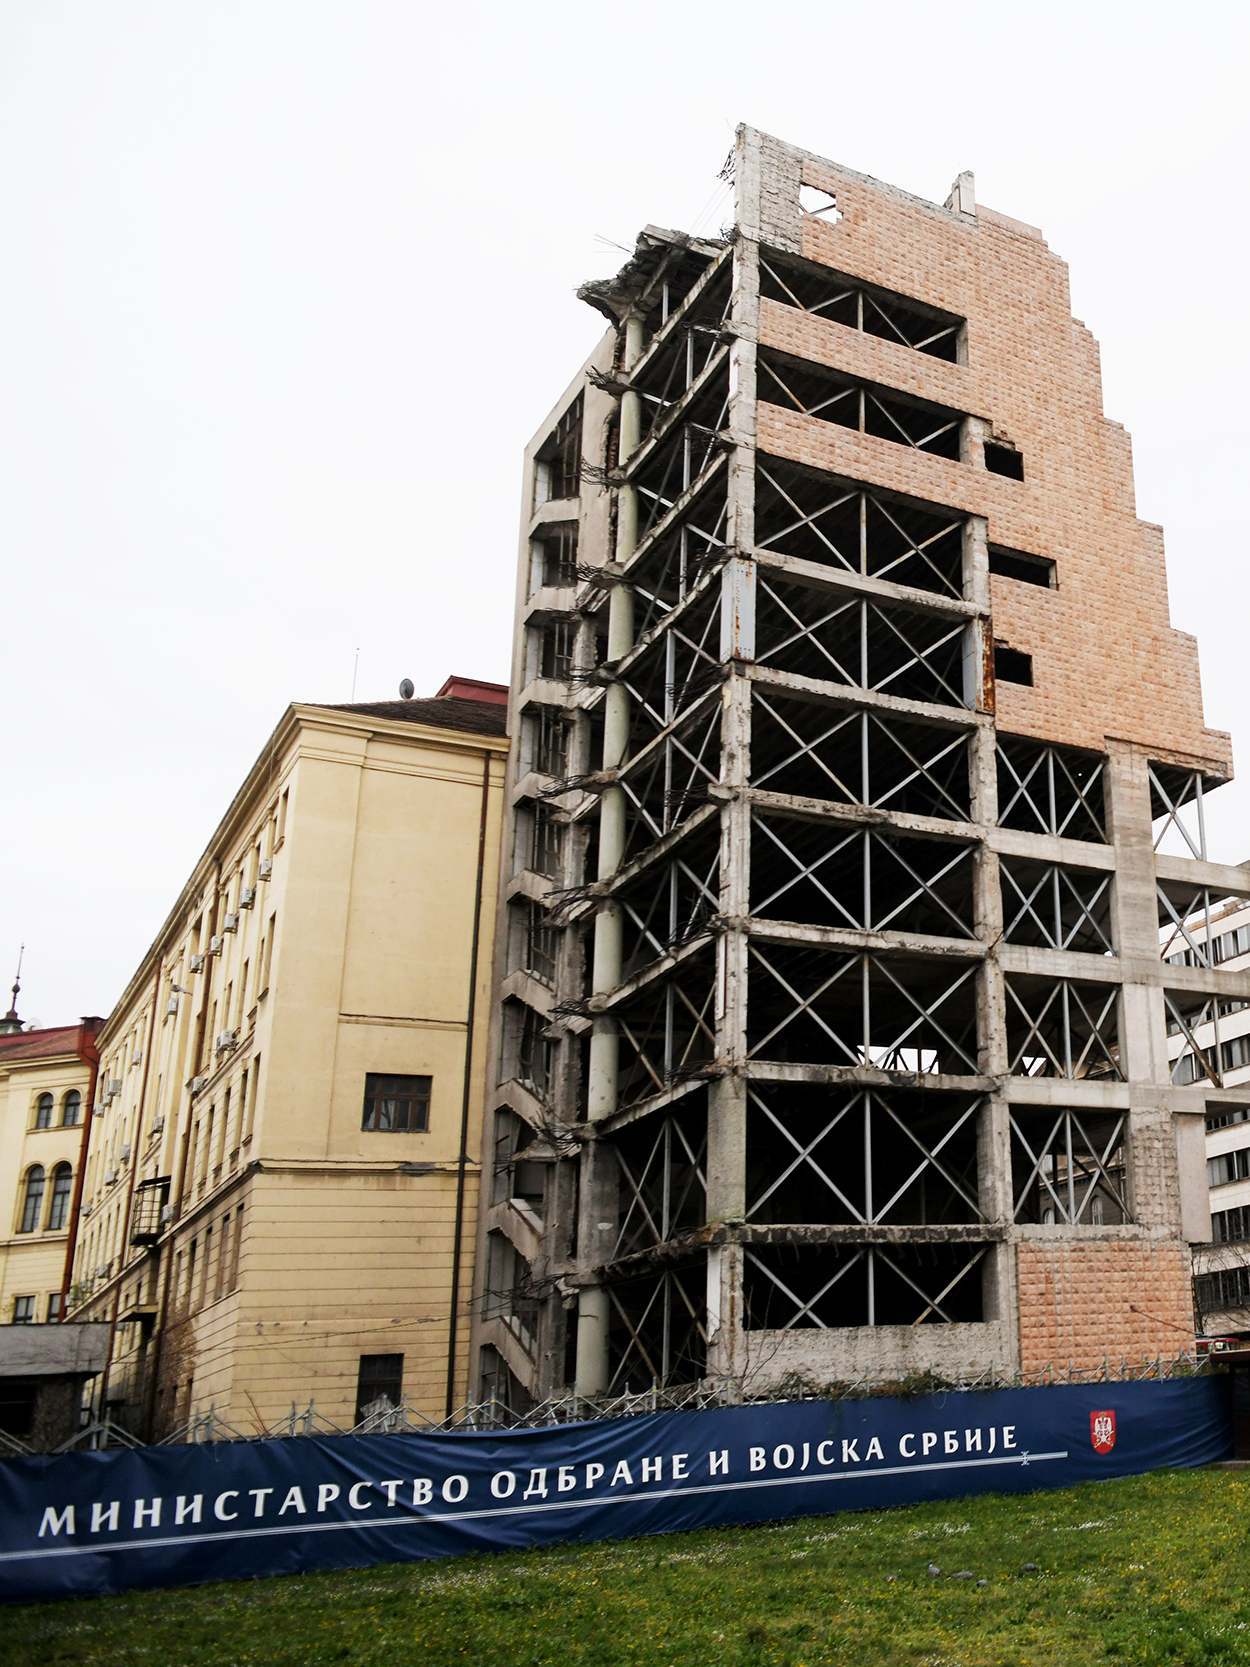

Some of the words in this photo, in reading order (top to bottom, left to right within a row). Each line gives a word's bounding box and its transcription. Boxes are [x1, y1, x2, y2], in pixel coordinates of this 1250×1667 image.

[39, 1475, 470, 1538] МИНИСТАРСТВО
[490, 1453, 691, 1501] ОДБРАНЕ
[708, 1449, 730, 1476] И
[749, 1436, 886, 1473] ВОЈСКА
[898, 1424, 1018, 1459] СРБИЈЕ
